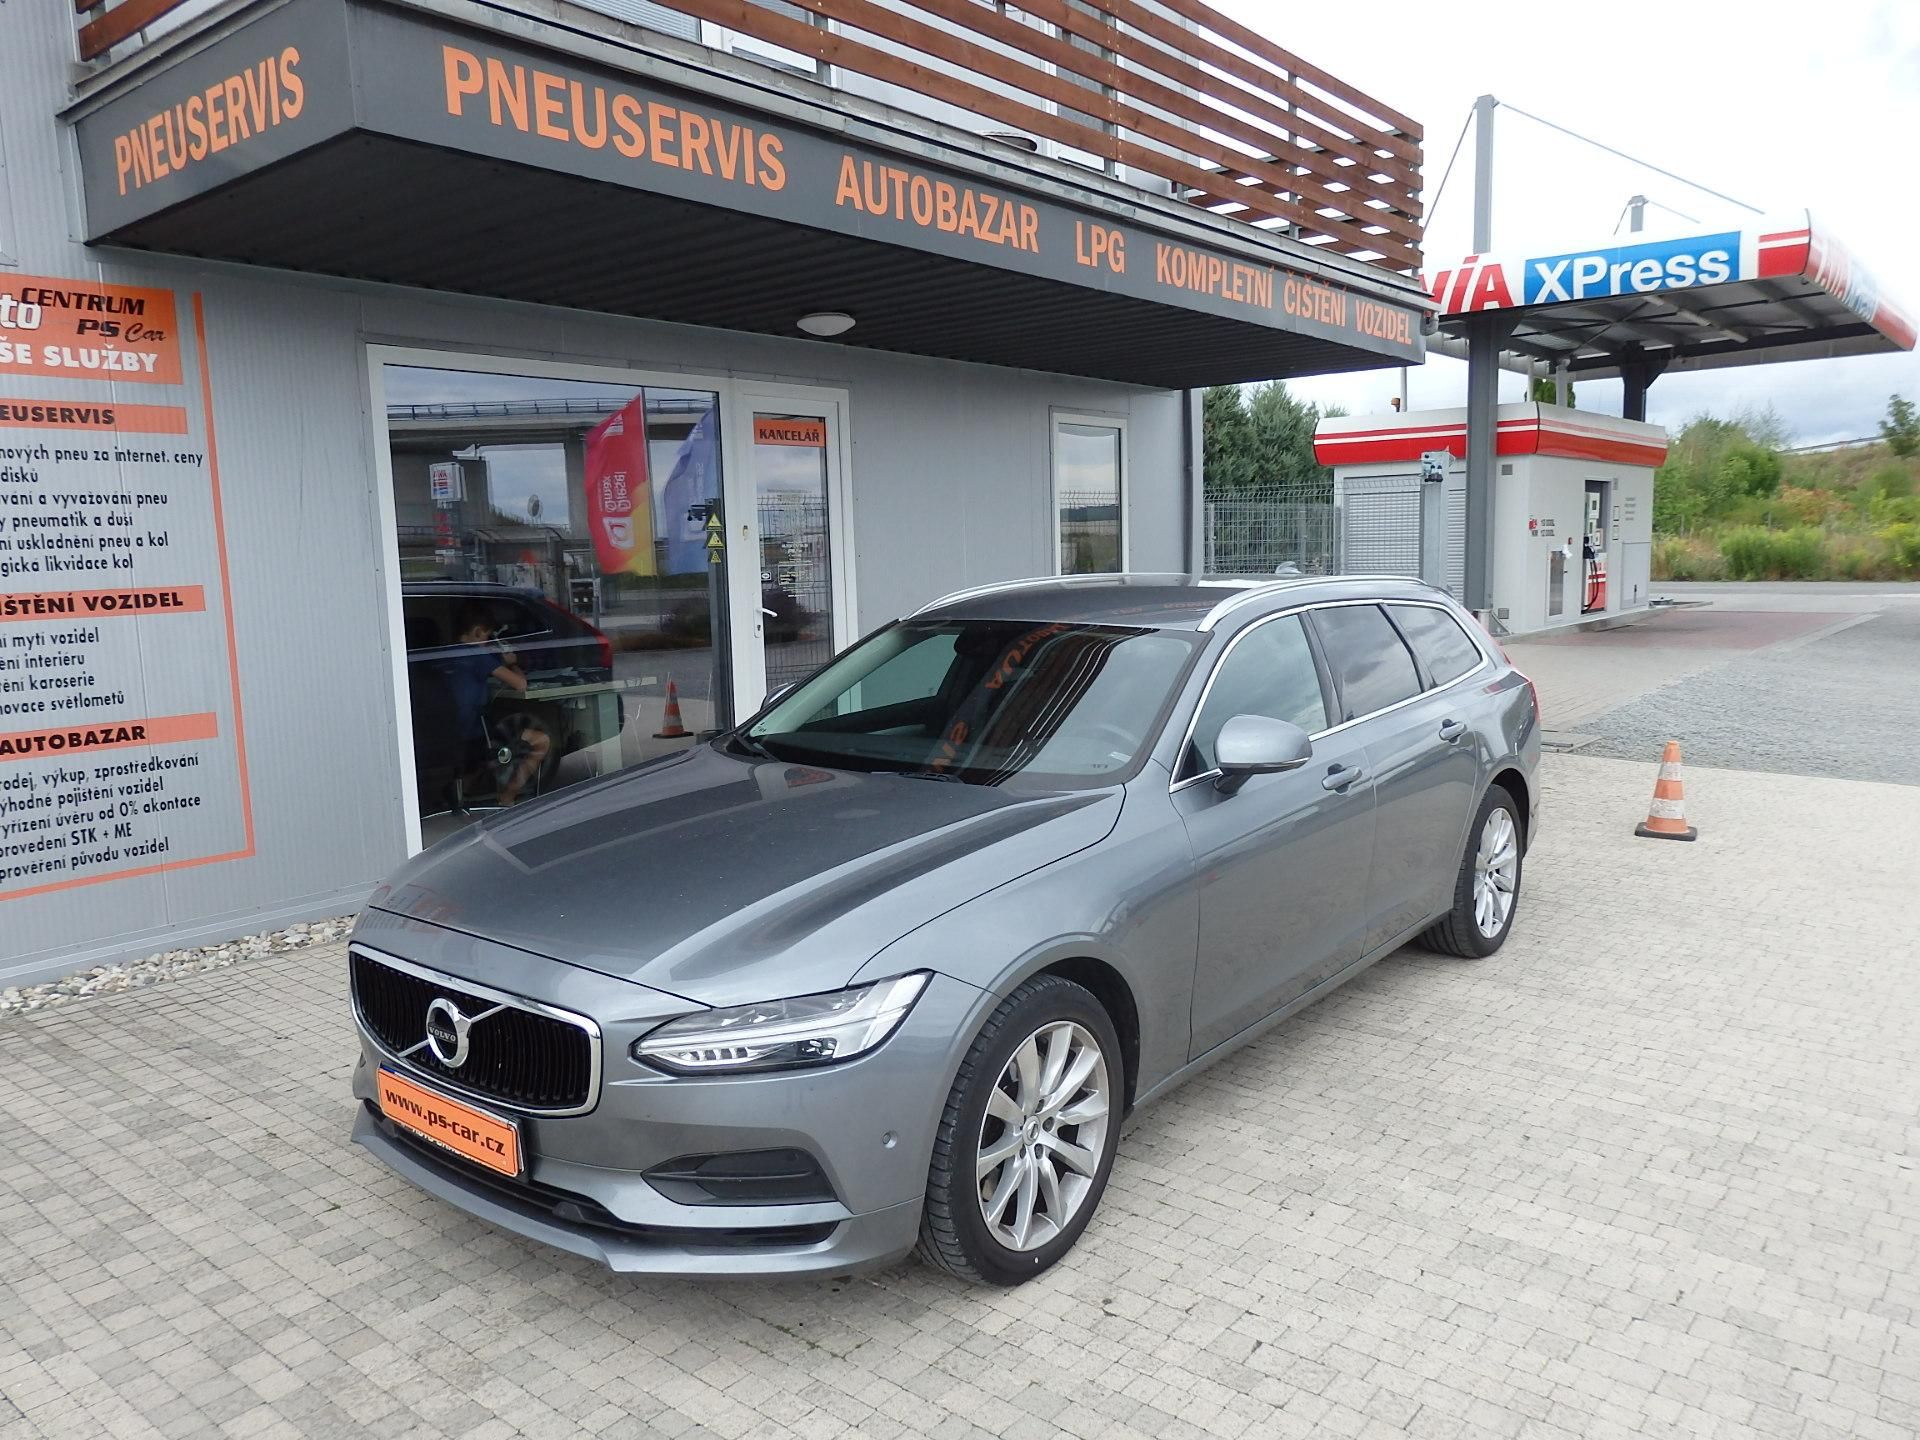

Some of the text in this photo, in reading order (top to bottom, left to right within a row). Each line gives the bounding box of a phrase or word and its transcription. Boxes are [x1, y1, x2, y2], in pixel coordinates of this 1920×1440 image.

[114, 45, 304, 196] PNEUSERVIS
[442, 45, 1413, 345] PNEUSERVIS AUTOBAZAR LPG KOMPLETNÍ ČIŠTĚNÍ VOZIDEL
[1533, 249, 1731, 304] XPress
[20, 286, 146, 316] CENTRUM
[75, 318, 168, 343] PS Car
[43, 343, 158, 373] SLUŽBY
[0, 404, 116, 425] EUSERVIS
[759, 428, 820, 442] KANCELÁŘ
[55, 449, 88, 464] pneu
[93, 450, 109, 461] za
[114, 446, 170, 463] internet.
[174, 453, 203, 468] ceny
[0, 465, 39, 483] disků
[1, 490, 168, 509] vání a vyvažování pneu
[12, 510, 88, 532] pneumatik
[93, 516, 102, 527] a
[107, 510, 133, 527] duší
[17, 532, 94, 550] uskladnění
[99, 536, 131, 552] pneu
[135, 536, 144, 547] a
[148, 530, 169, 547] kol
[1, 553, 134, 577] gická likvidace kol
[82, 592, 184, 611] VOZIDEL
[12, 631, 46, 650] mytí
[50, 626, 100, 645] vozidel
[24, 651, 86, 668] interiéru
[29, 671, 95, 690] karoserie
[51, 691, 125, 711] světlometů
[0, 725, 147, 755] AUTOBAZAR
[42, 768, 90, 788] výkup,
[94, 751, 200, 782] zprostředkování
[57, 785, 114, 809] pojištění
[118, 776, 164, 796] vozidel
[56, 808, 94, 827] úvěru
[99, 803, 115, 820] od
[119, 800, 139, 817] 0%
[143, 796, 201, 814] akontace
[71, 827, 98, 847] STK
[103, 830, 110, 839] +
[114, 822, 133, 839] ME
[71, 846, 120, 871] původu
[123, 837, 170, 859] vozidel
[429, 1026, 456, 1042] VOLVO
[385, 1089, 506, 1157] www.ps-car.cz
